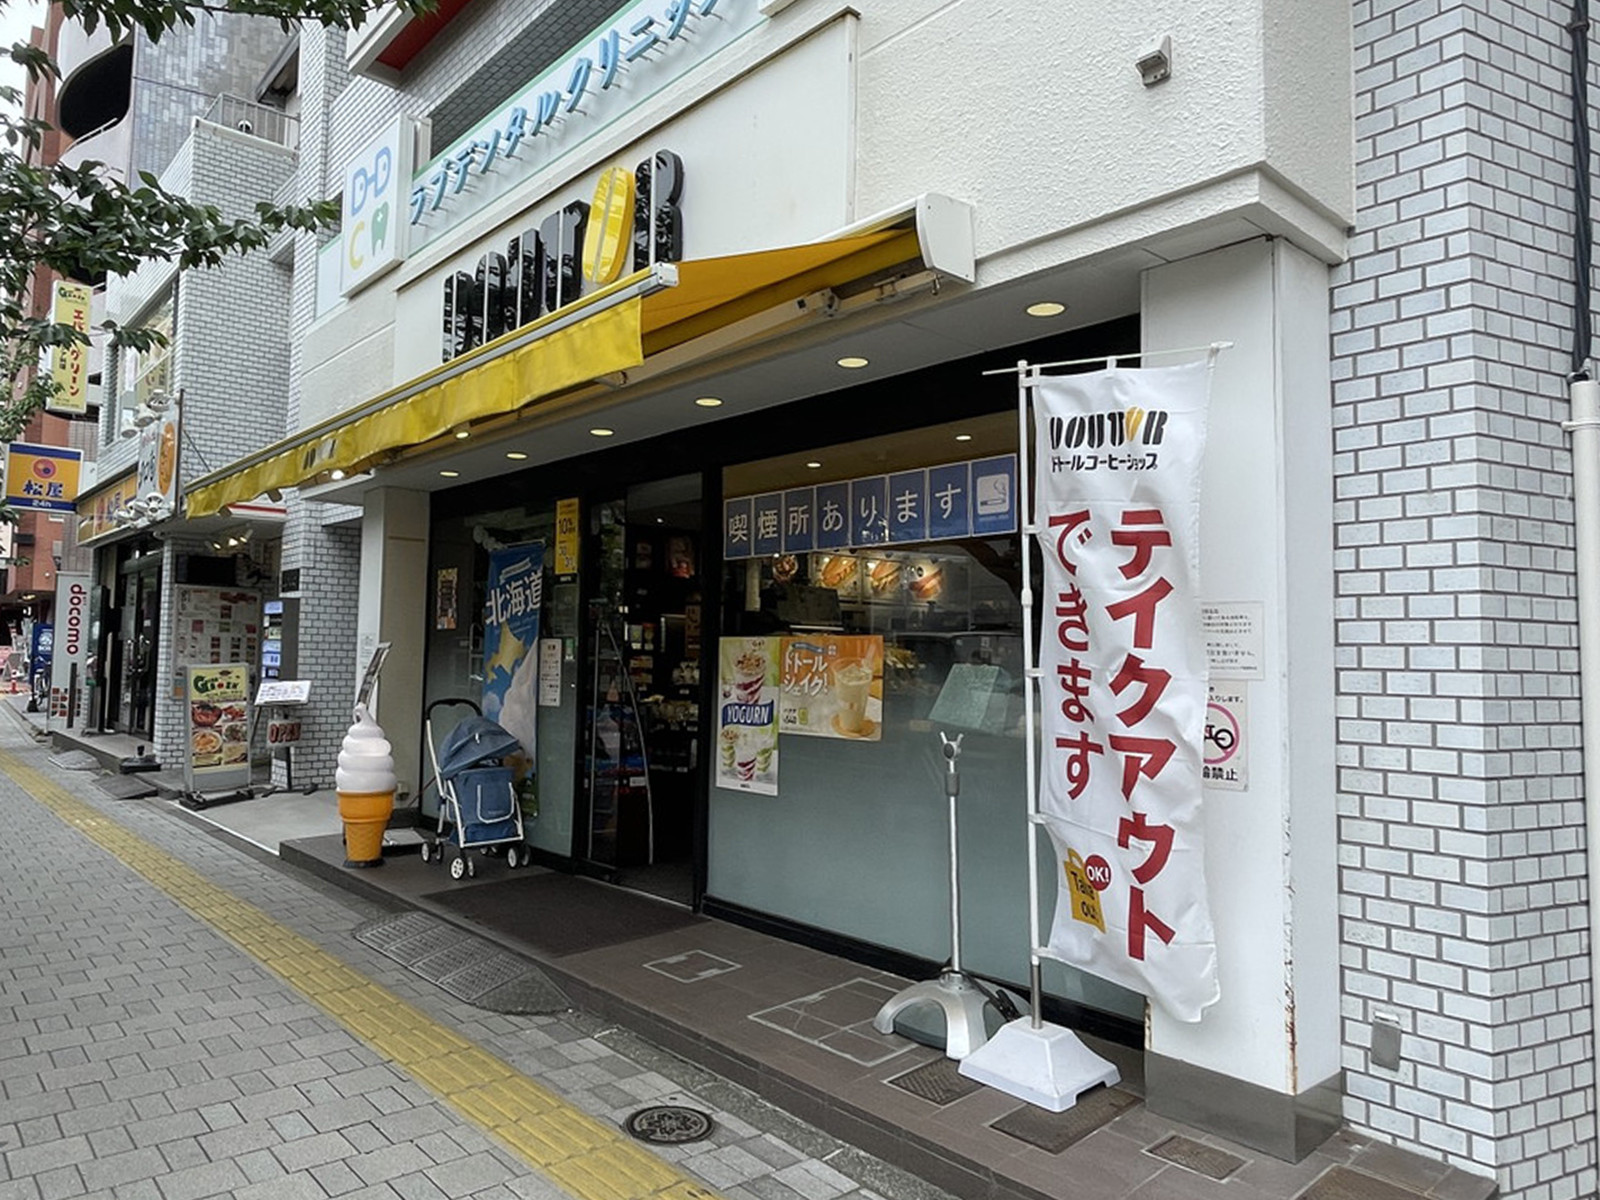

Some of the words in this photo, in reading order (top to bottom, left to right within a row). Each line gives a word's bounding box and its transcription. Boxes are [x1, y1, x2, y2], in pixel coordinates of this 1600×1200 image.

[410, 0, 718, 225] ラブデンタルクリニッ
[442, 148, 685, 364] DOUTOR
[1050, 406, 1168, 450] DOUTOR
[728, 483, 962, 543] 喫煙所あります
[67, 584, 87, 655] docomo
[485, 567, 542, 627] 北海道
[785, 651, 829, 674] ドトール
[1049, 509, 1104, 801] できます
[726, 705, 770, 724] YOGURN
[1105, 509, 1177, 961] テイクアウト
[1086, 865, 1110, 882] OK!
